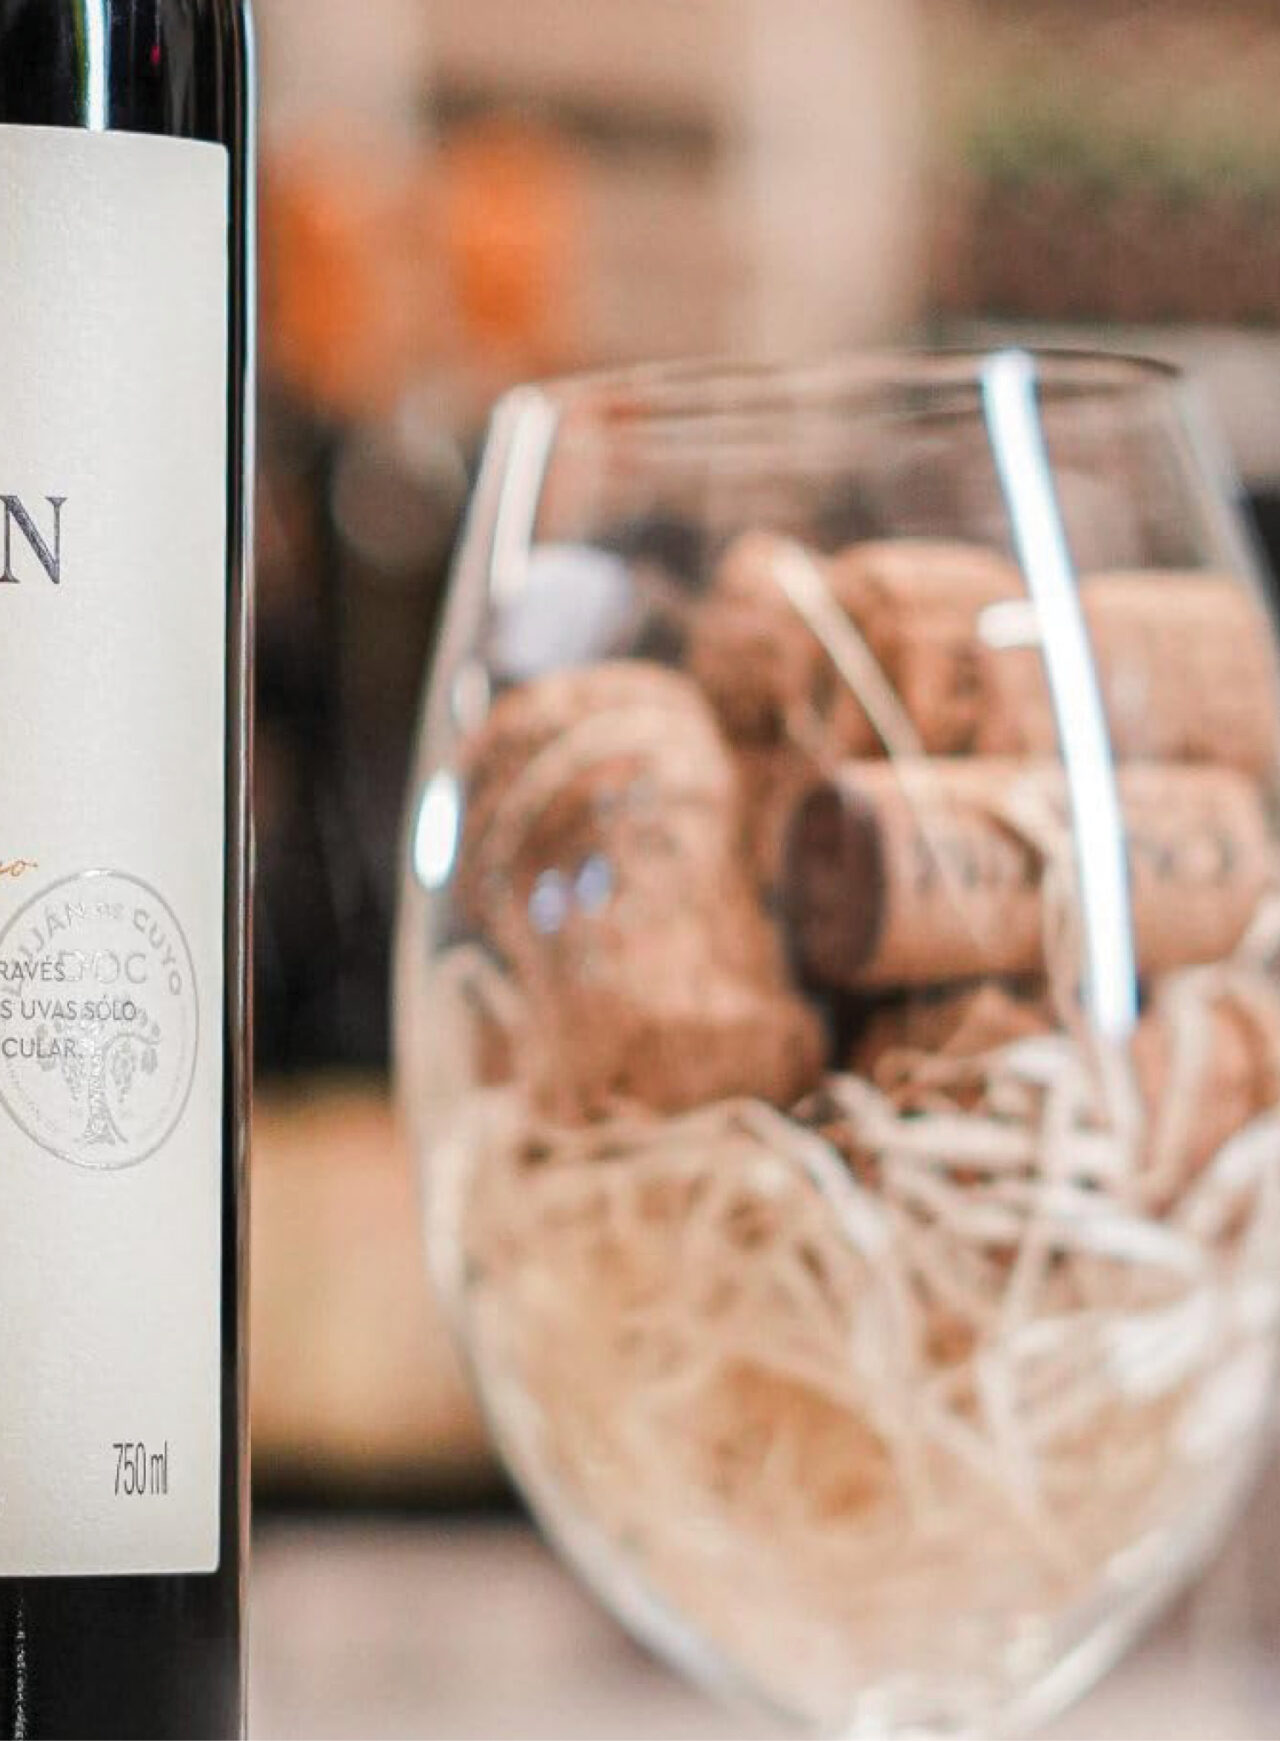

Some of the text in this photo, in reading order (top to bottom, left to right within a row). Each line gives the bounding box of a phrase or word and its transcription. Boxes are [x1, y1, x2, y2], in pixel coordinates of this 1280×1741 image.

[131, 907, 184, 996] CUYO
[21, 999, 77, 1021] UVAS
[113, 1440, 167, 1496] 750 ml
